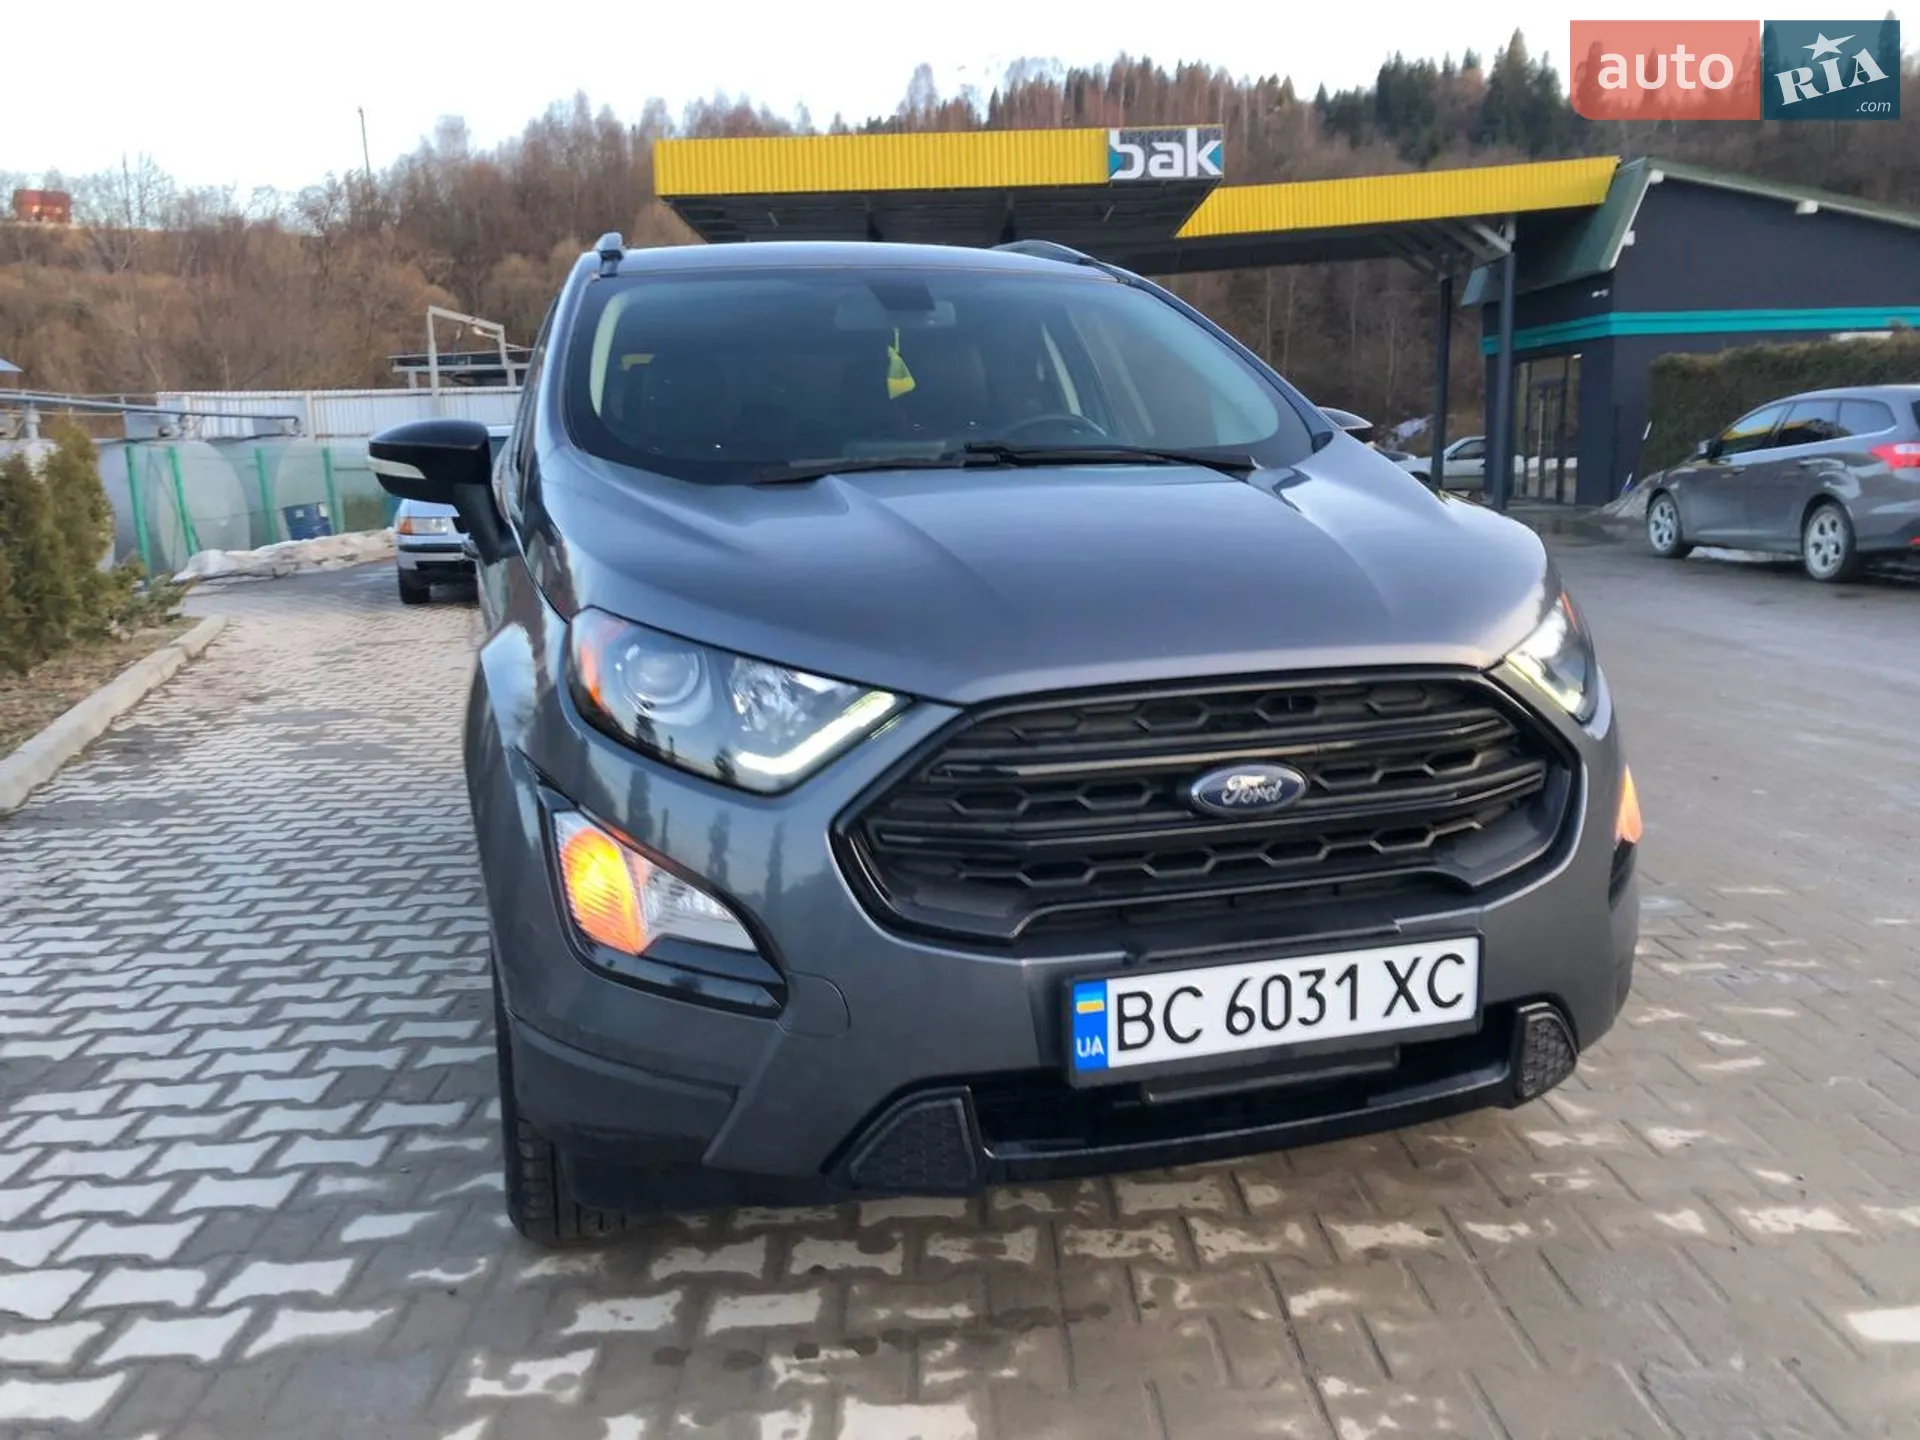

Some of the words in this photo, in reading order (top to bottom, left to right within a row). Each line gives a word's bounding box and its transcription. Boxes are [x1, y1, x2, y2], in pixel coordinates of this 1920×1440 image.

[1109, 128, 1224, 179] bak
[1221, 774, 1283, 806] Ford
[1116, 985, 1204, 1052] BC
[1225, 963, 1359, 1037] 6031
[1382, 953, 1467, 1017] XC
[1076, 1038, 1105, 1058] UA
